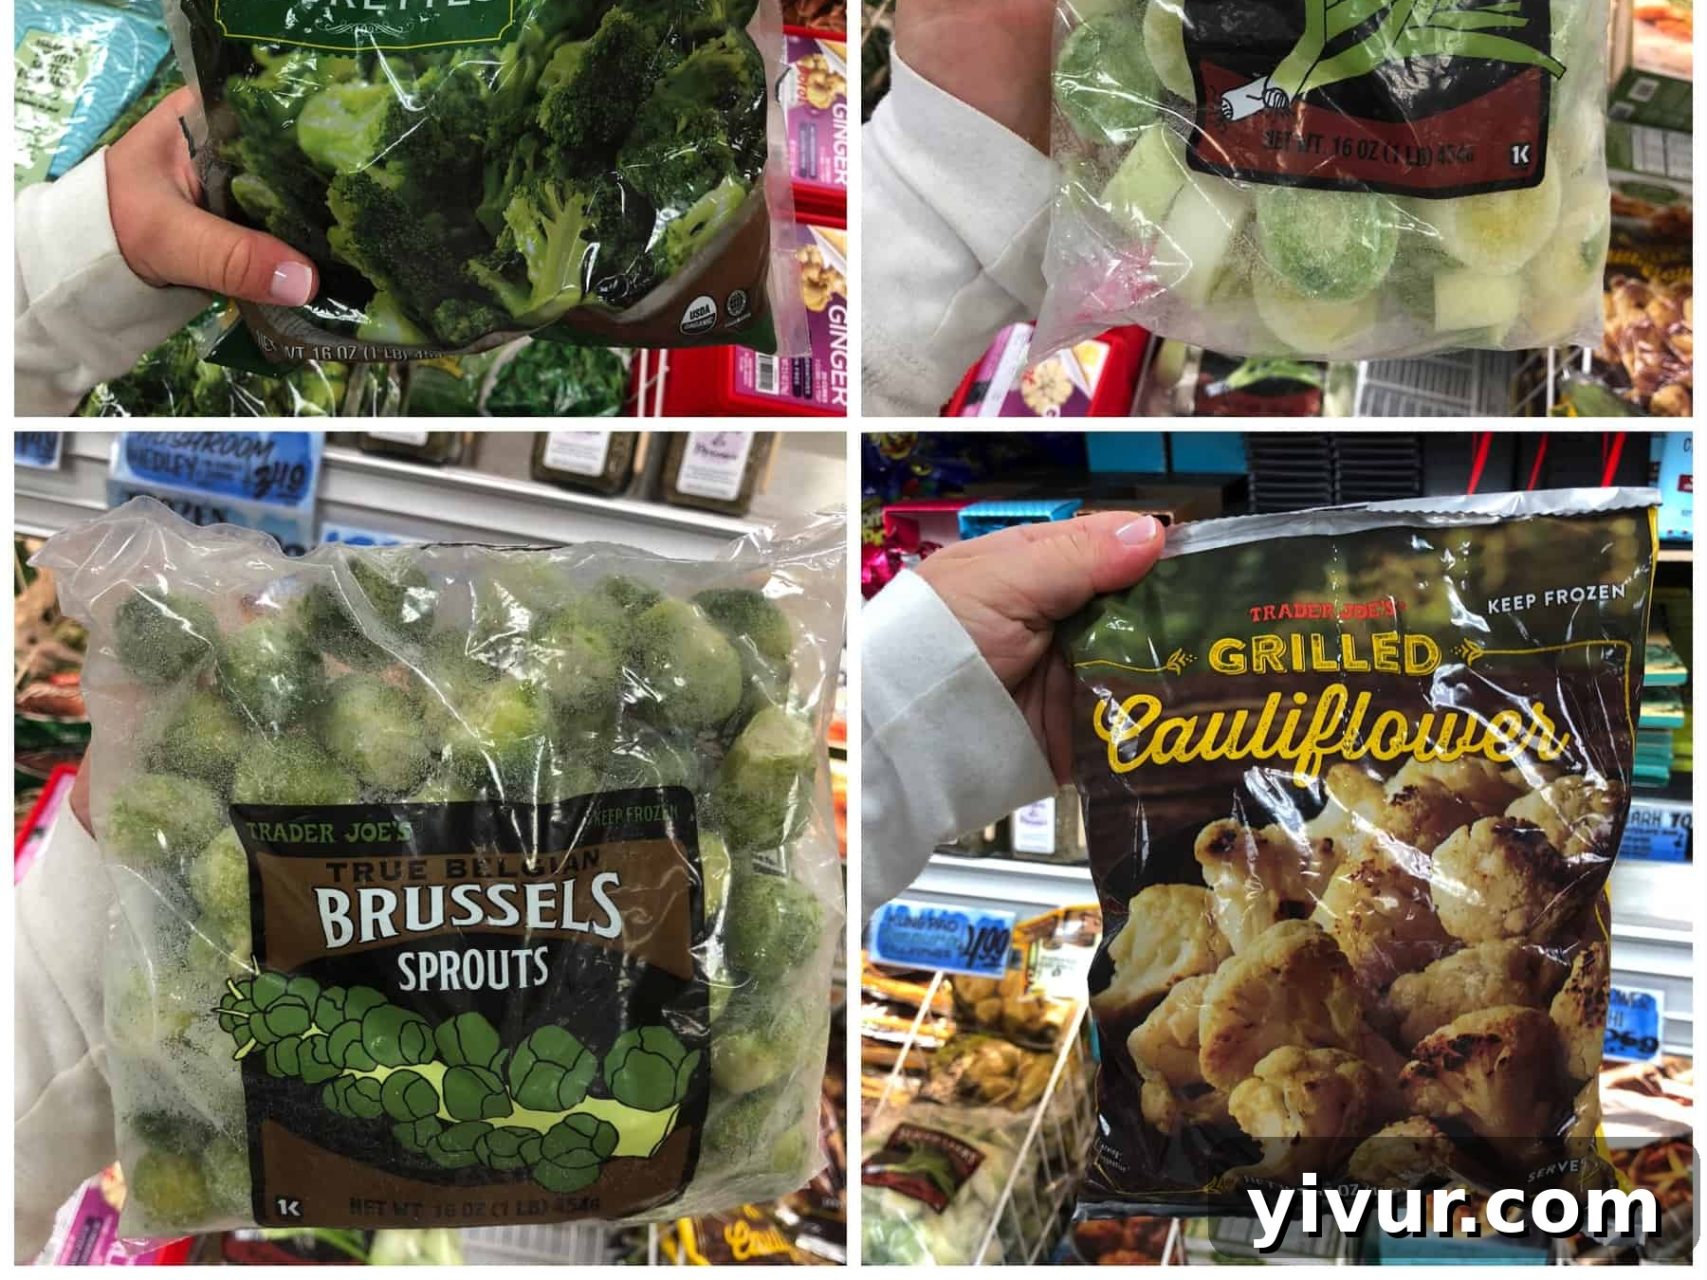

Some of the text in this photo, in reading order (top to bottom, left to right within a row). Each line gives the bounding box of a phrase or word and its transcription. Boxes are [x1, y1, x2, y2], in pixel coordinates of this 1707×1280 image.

[1357, 140, 1379, 160] OZ
[313, 346, 332, 361] 16
[828, 304, 848, 408] GINGER
[1250, 600, 1397, 622] TRADER JOE'S
[1488, 584, 1626, 615] KEEP FROZEN
[1208, 632, 1444, 677] GRILLED
[1094, 683, 1570, 789] Cauliflower
[248, 821, 411, 843] TRADER JOE'S
[326, 849, 599, 883] TRUE BELGIAN
[313, 872, 623, 949] BRUSSELS
[398, 946, 548, 992] SPROUTS
[462, 1201, 486, 1217] OZ
